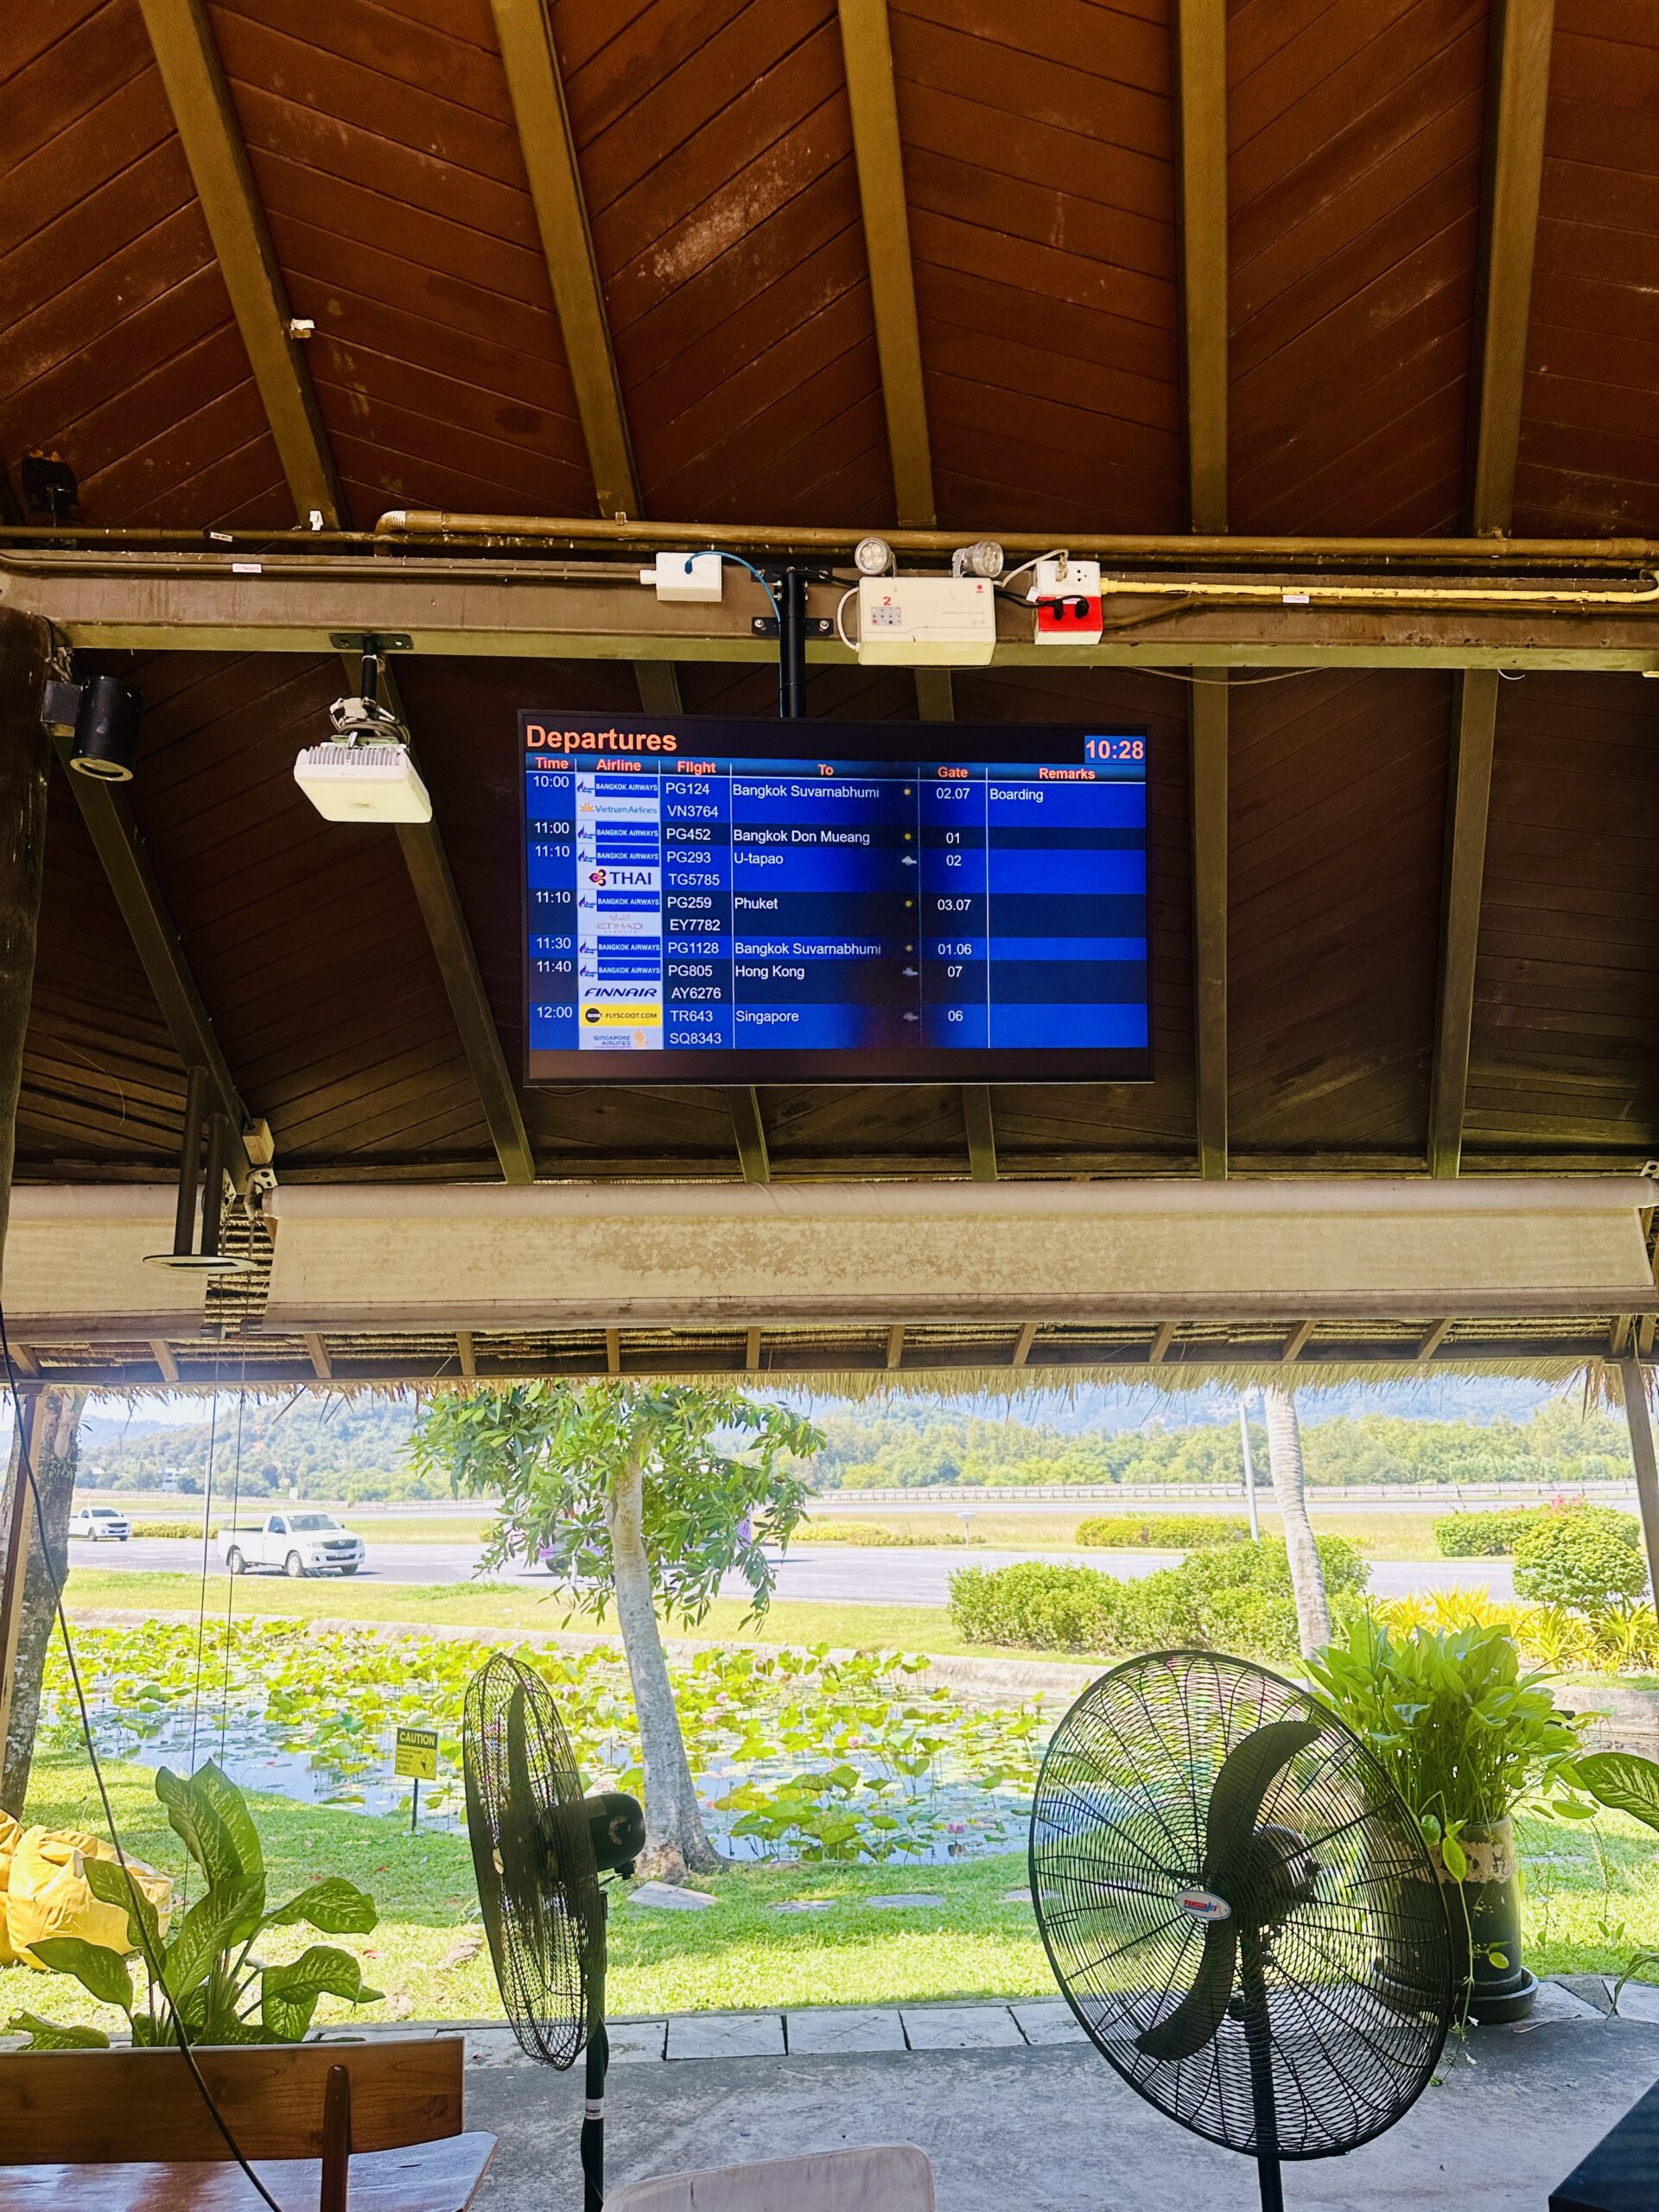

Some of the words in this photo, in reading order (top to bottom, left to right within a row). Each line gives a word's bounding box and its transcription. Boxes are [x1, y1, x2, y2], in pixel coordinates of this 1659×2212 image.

[883, 596, 892, 606] 2
[527, 725, 677, 753] Departures
[1086, 741, 1143, 759] 10:28
[535, 757, 569, 769] Time
[596, 759, 641, 771] Airline
[677, 761, 715, 775] Flight
[818, 765, 834, 775] To
[938, 766, 968, 778] Gate
[1039, 768, 1095, 779] Remarks
[534, 776, 569, 787] 10:00
[666, 783, 709, 794] PG124
[734, 785, 787, 798] Bangkok
[791, 785, 879, 798] Suvarnabhumi
[937, 788, 969, 799] 02.07
[990, 789, 1043, 803] Boarding
[667, 805, 718, 817] VN3764
[535, 822, 569, 833] 11:00
[667, 829, 710, 840] PG452
[734, 830, 787, 844] Bangkok
[791, 830, 817, 842] Don
[821, 831, 869, 845] Mueang
[946, 833, 959, 843] 01
[536, 845, 569, 856] 11:10
[667, 851, 710, 863] PG293
[734, 853, 783, 867] U-tapao
[947, 855, 961, 866] 02
[609, 872, 652, 885] THAI
[669, 874, 720, 886] TG5785
[537, 892, 570, 903] 11:10
[668, 897, 711, 908] PG259
[735, 898, 778, 909] Phuket
[938, 899, 971, 910] 03.07
[671, 919, 720, 931] EY7782
[537, 938, 570, 949] 11:30
[669, 942, 719, 953] PG1128
[735, 943, 789, 957] Bangkok
[793, 943, 880, 954] Suvarnabhumi
[938, 944, 971, 955] 01.06
[537, 961, 571, 972] 11:40
[669, 965, 712, 976] PG805
[948, 966, 963, 977] 07
[736, 965, 768, 979] Hong
[772, 966, 804, 980] Kong
[671, 988, 721, 999] AY6276
[537, 1007, 572, 1018] 12:00
[671, 1010, 713, 1021] TR643
[736, 1011, 798, 1024] Singapore
[949, 1010, 963, 1021] 06
[670, 1033, 721, 1044] SQ8343
[399, 1732, 435, 1746] CAUTION
